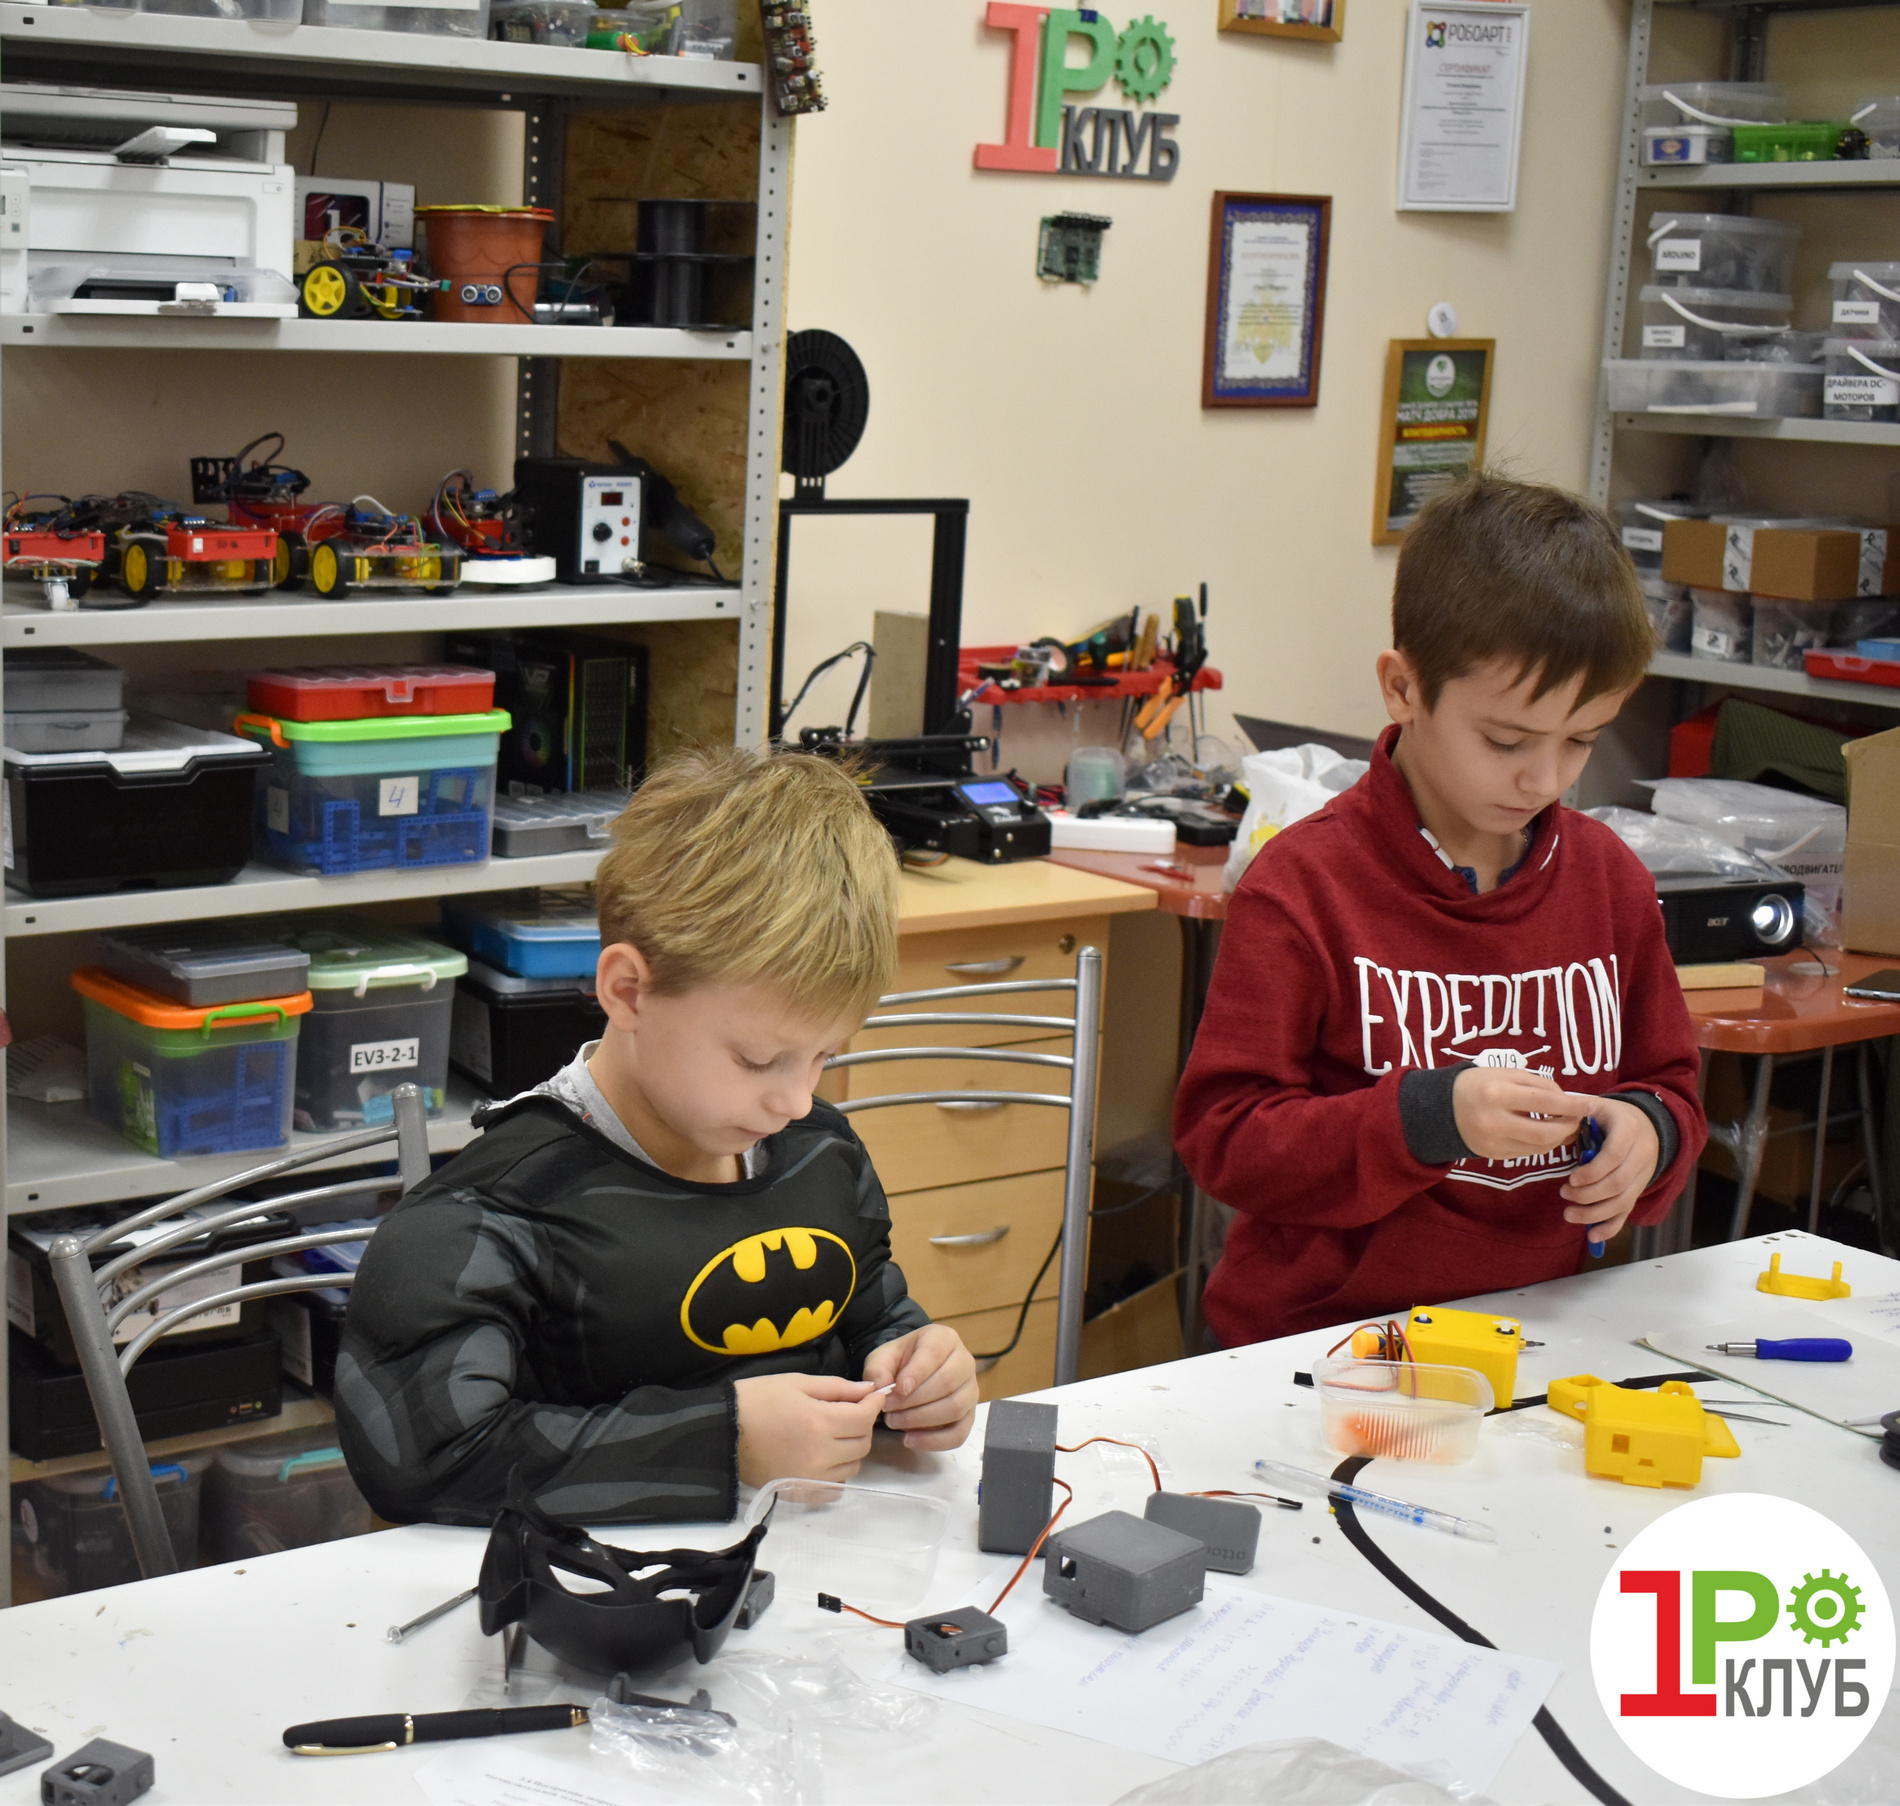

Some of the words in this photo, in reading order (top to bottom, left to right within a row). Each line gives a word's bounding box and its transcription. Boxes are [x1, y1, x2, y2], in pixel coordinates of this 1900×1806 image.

[1057, 105, 1181, 182] КЛУБ
[1661, 250, 1696, 260] ARDUINO
[1826, 378, 1868, 388] ДРАЙВЕРА
[1833, 392, 1876, 401] МОТОРОВ
[389, 786, 405, 808] 4
[1353, 953, 1623, 1076] EXPEDITION
[354, 1045, 417, 1067] EV3-2-1
